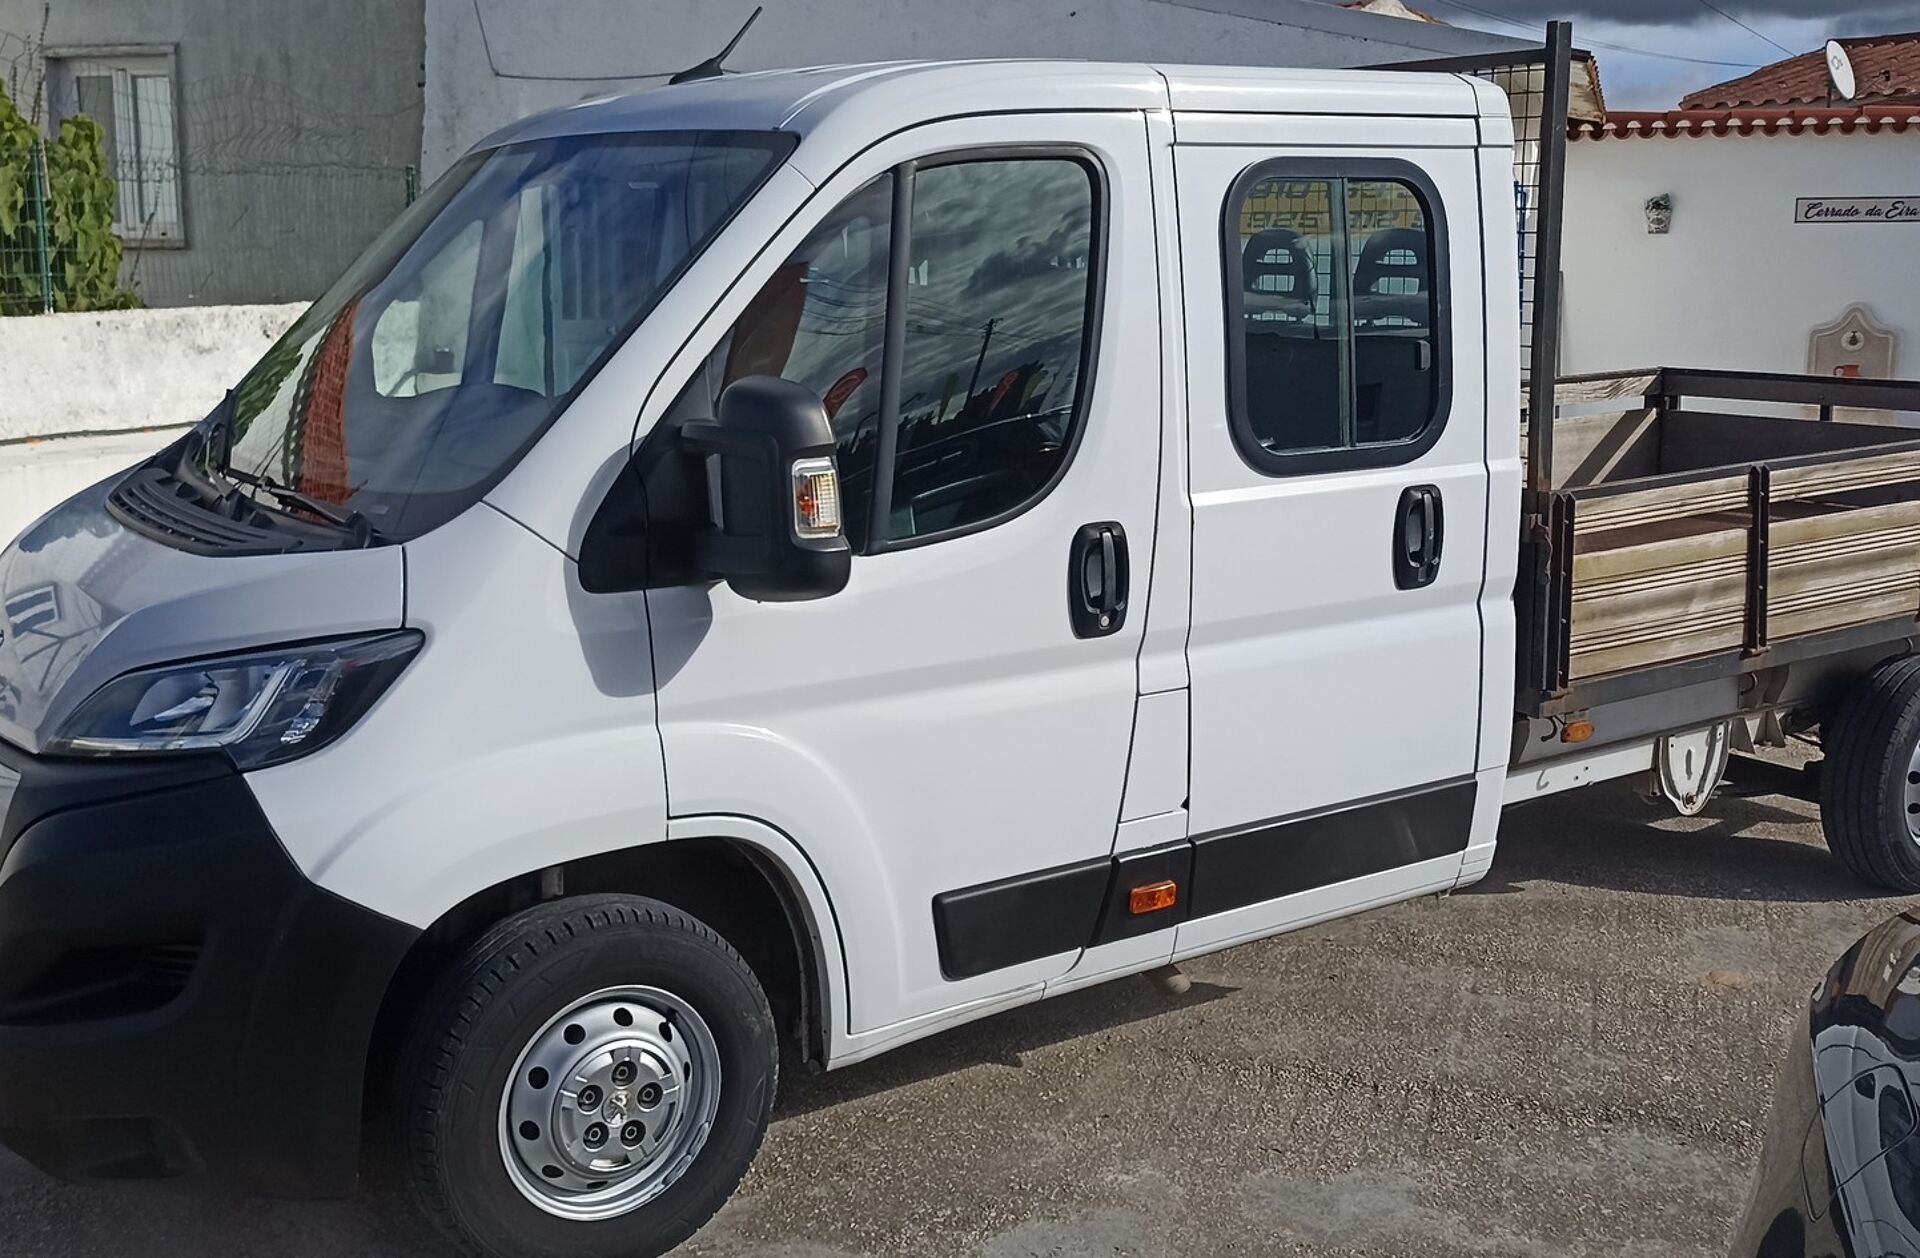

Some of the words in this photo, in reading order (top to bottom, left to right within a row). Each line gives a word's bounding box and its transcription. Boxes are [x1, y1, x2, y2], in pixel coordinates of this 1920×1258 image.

[1804, 202, 1860, 219] Cerrado
[1865, 205, 1883, 217] da
[1884, 200, 1920, 219] Eira
